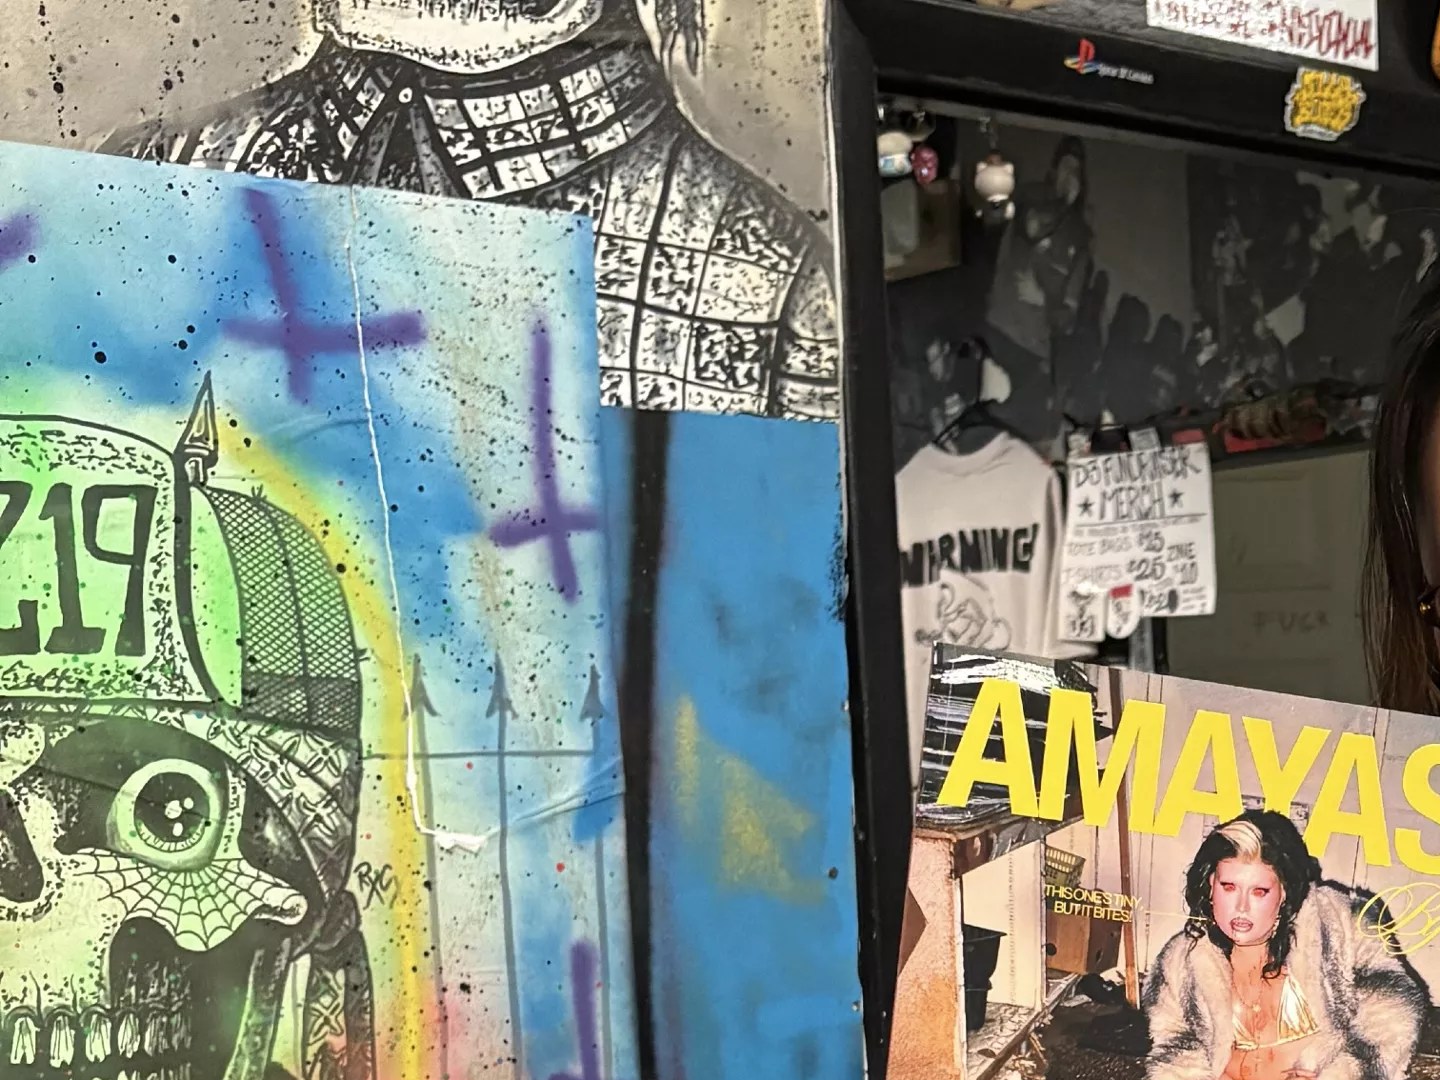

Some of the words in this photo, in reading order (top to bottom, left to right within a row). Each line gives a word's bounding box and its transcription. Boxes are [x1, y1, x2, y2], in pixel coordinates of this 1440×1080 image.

[1100, 482, 1165, 521] MERCH
[1045, 884, 1073, 900] THIS
[1054, 900, 1081, 915] BUT
[1082, 905, 1094, 917] IT
[1094, 907, 1133, 923] BITES!
